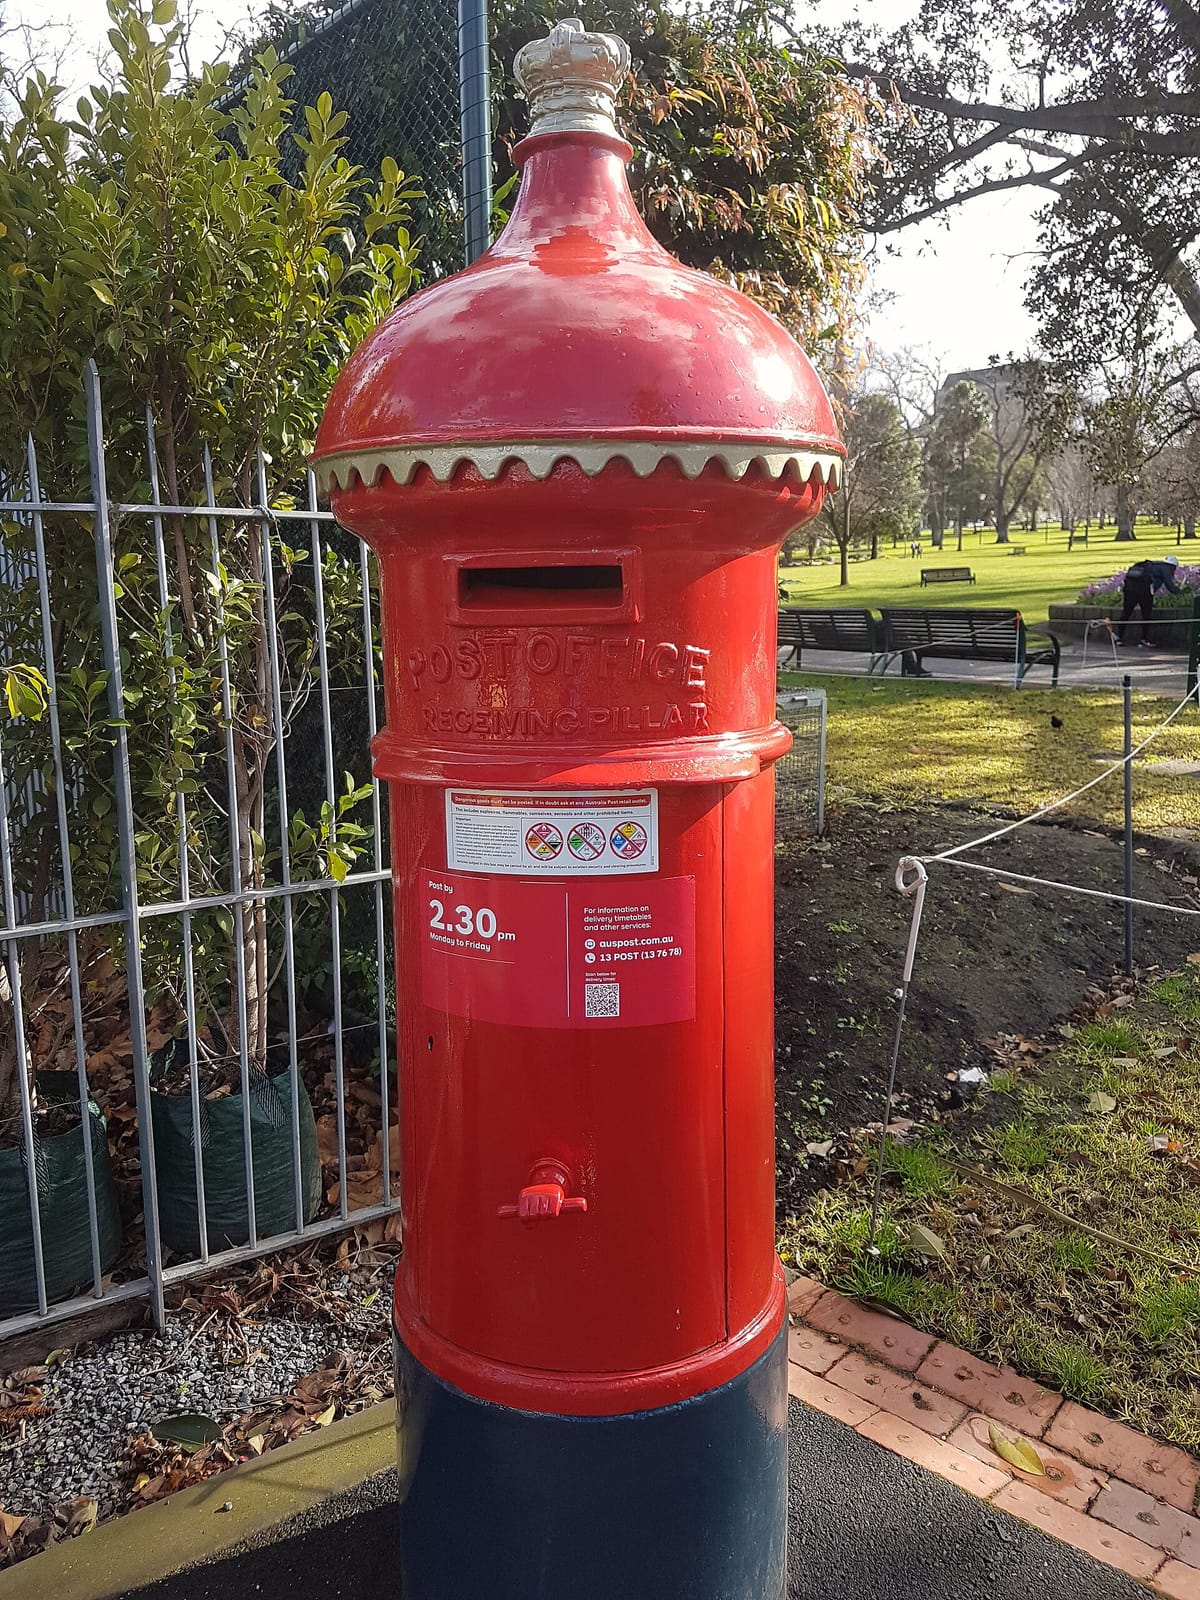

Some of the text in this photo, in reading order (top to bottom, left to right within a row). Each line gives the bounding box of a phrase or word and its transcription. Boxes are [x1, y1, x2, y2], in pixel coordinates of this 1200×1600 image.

[408, 630, 711, 690] POST OFFICE
[422, 702, 710, 735] RECEIVING PILLAR
[429, 881, 453, 894] Post by
[597, 905, 638, 914] information
[428, 899, 516, 941] 2.30 pm
[584, 913, 652, 924] delivery timetables
[430, 932, 490, 952] Monday to Friday
[599, 936, 674, 949] auspost.com.au
[600, 947, 682, 962] 13 POST (13 76 78)
